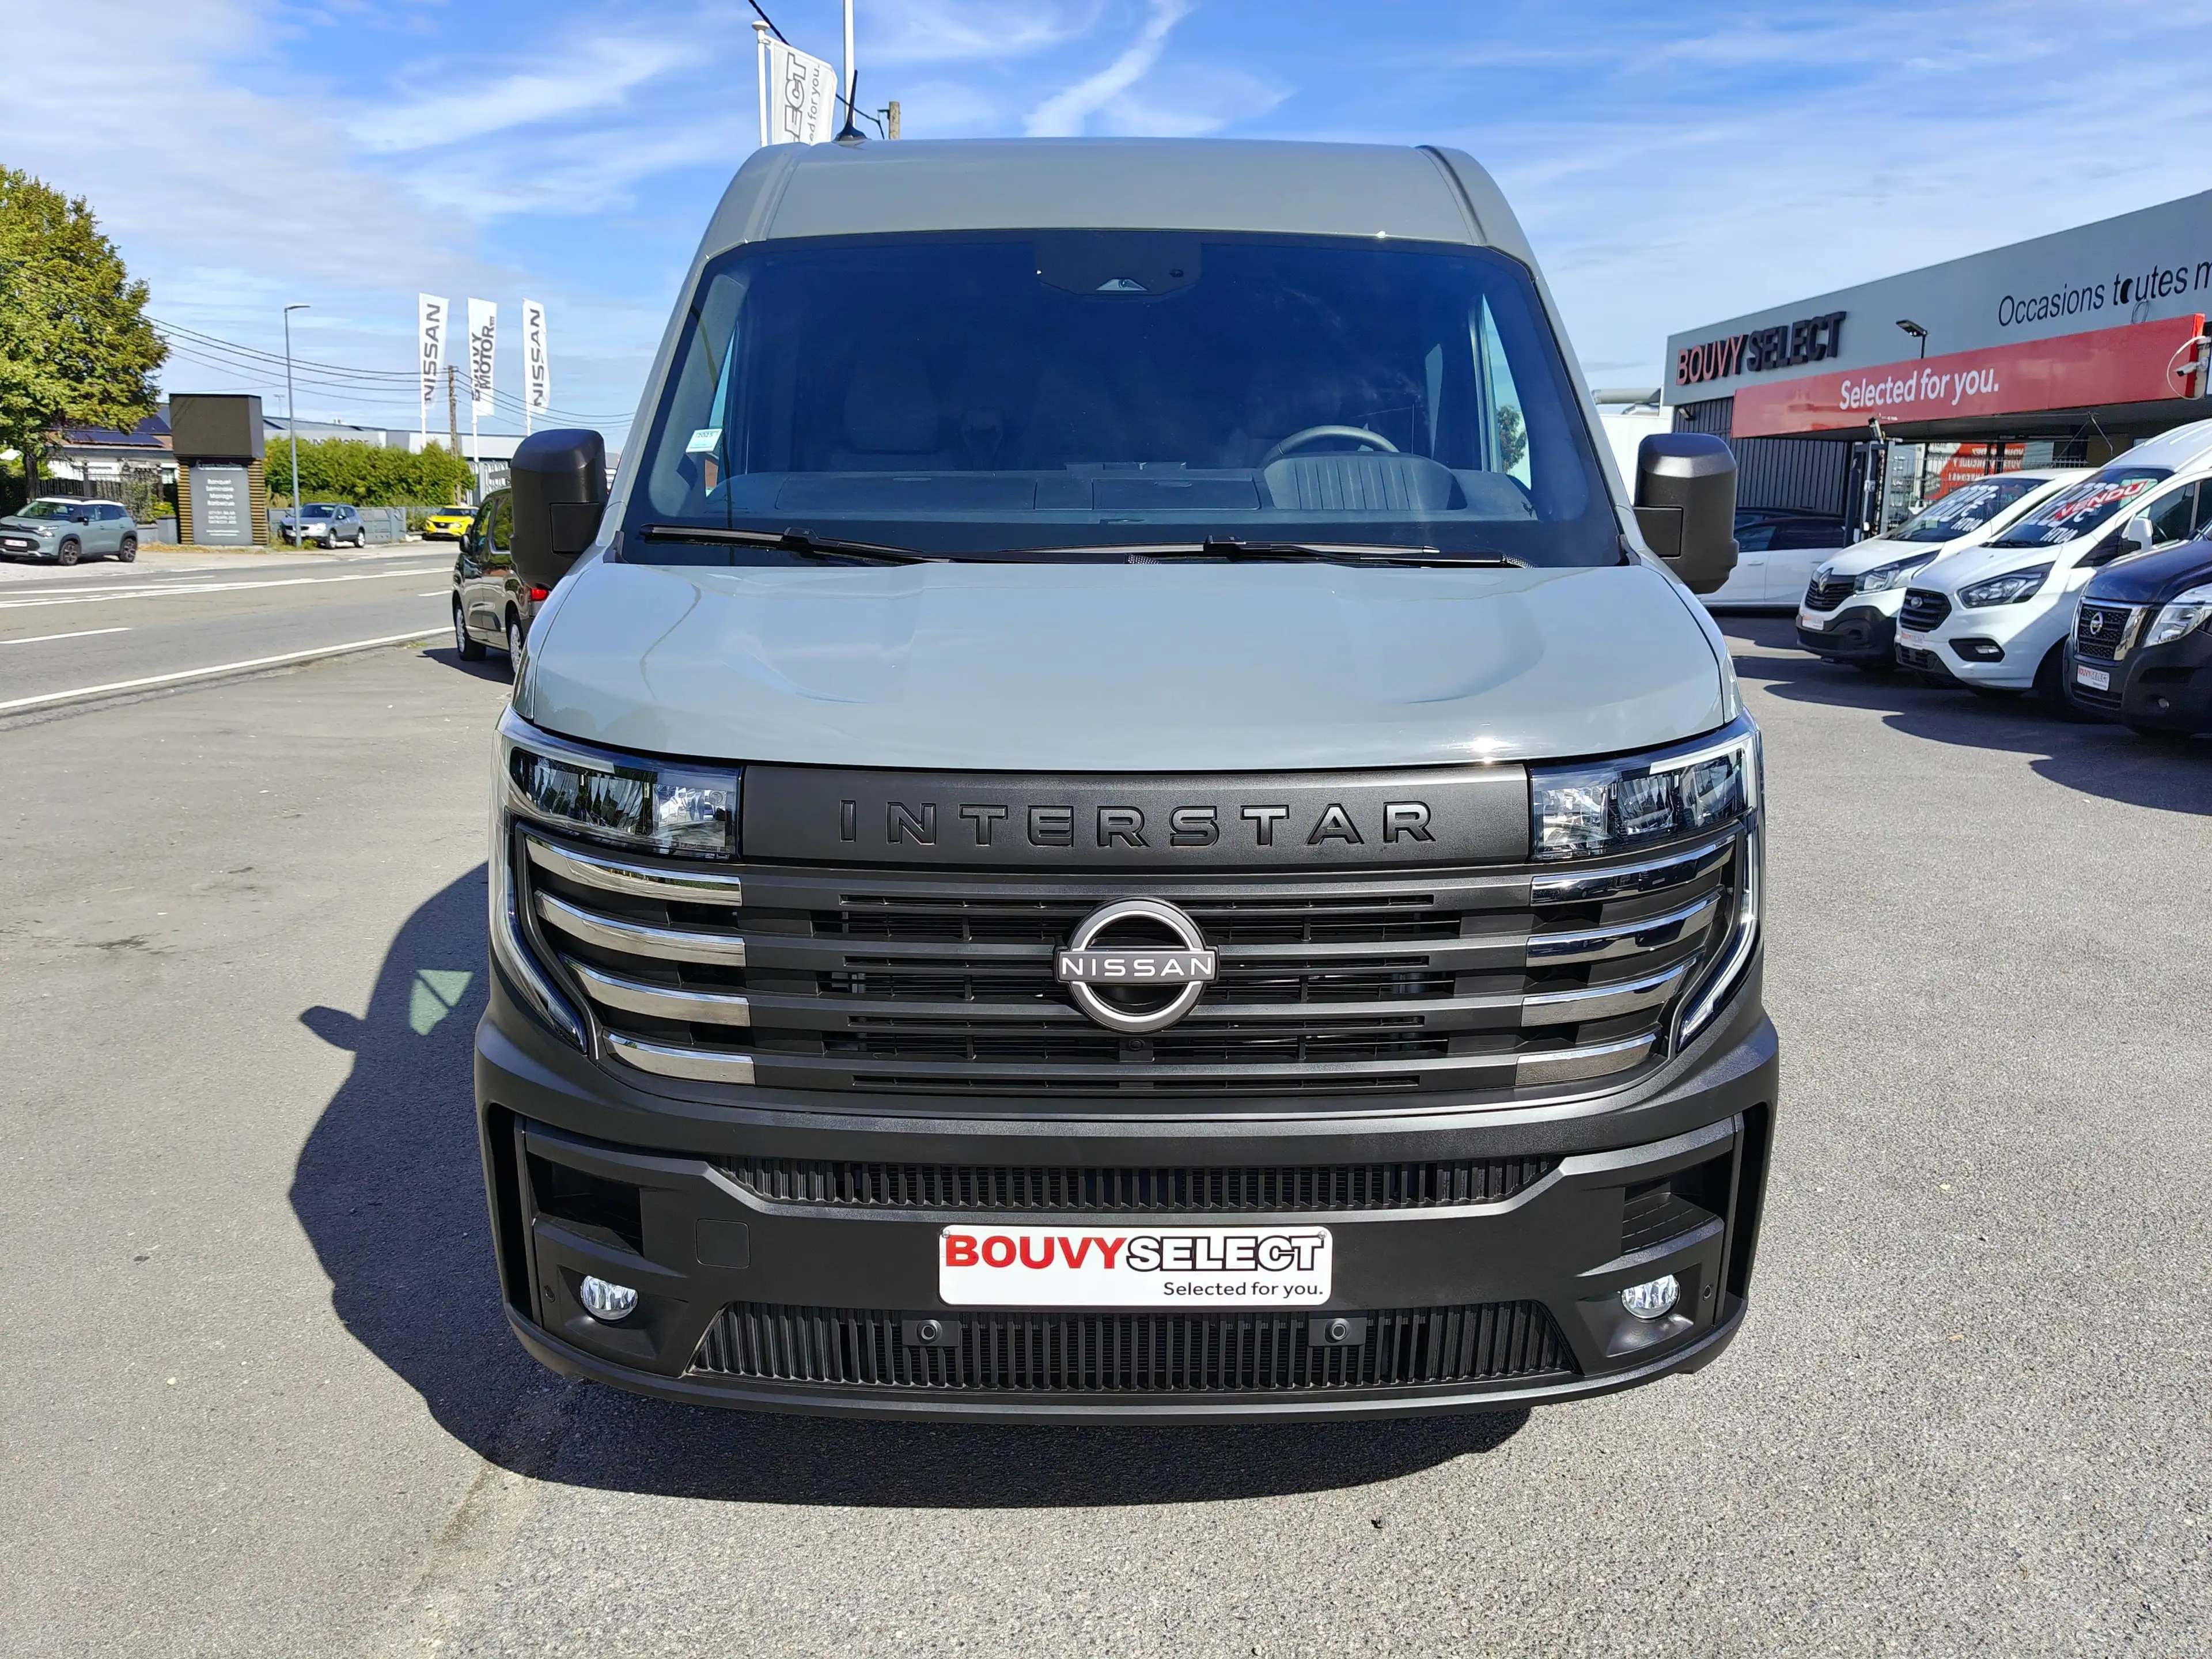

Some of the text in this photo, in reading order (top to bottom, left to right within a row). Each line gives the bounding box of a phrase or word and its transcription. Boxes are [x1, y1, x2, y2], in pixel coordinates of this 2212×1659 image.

[785, 52, 807, 143] ECT
[808, 65, 821, 145] ed for you.
[1998, 283, 2105, 327] Occasions
[2113, 265, 2188, 305] toutes
[423, 303, 441, 402] NISSAN
[479, 325, 494, 390] MOTOR
[529, 309, 544, 406] NISSAN
[1839, 368, 1999, 410] Selected for you.
[2061, 482, 2146, 517] VENDU
[2040, 527, 2078, 544] HTVA
[839, 799, 1437, 848] INTERSTAR
[1062, 957, 1211, 976] NISSAN
[1164, 1282, 1323, 1298] Selected for you.
